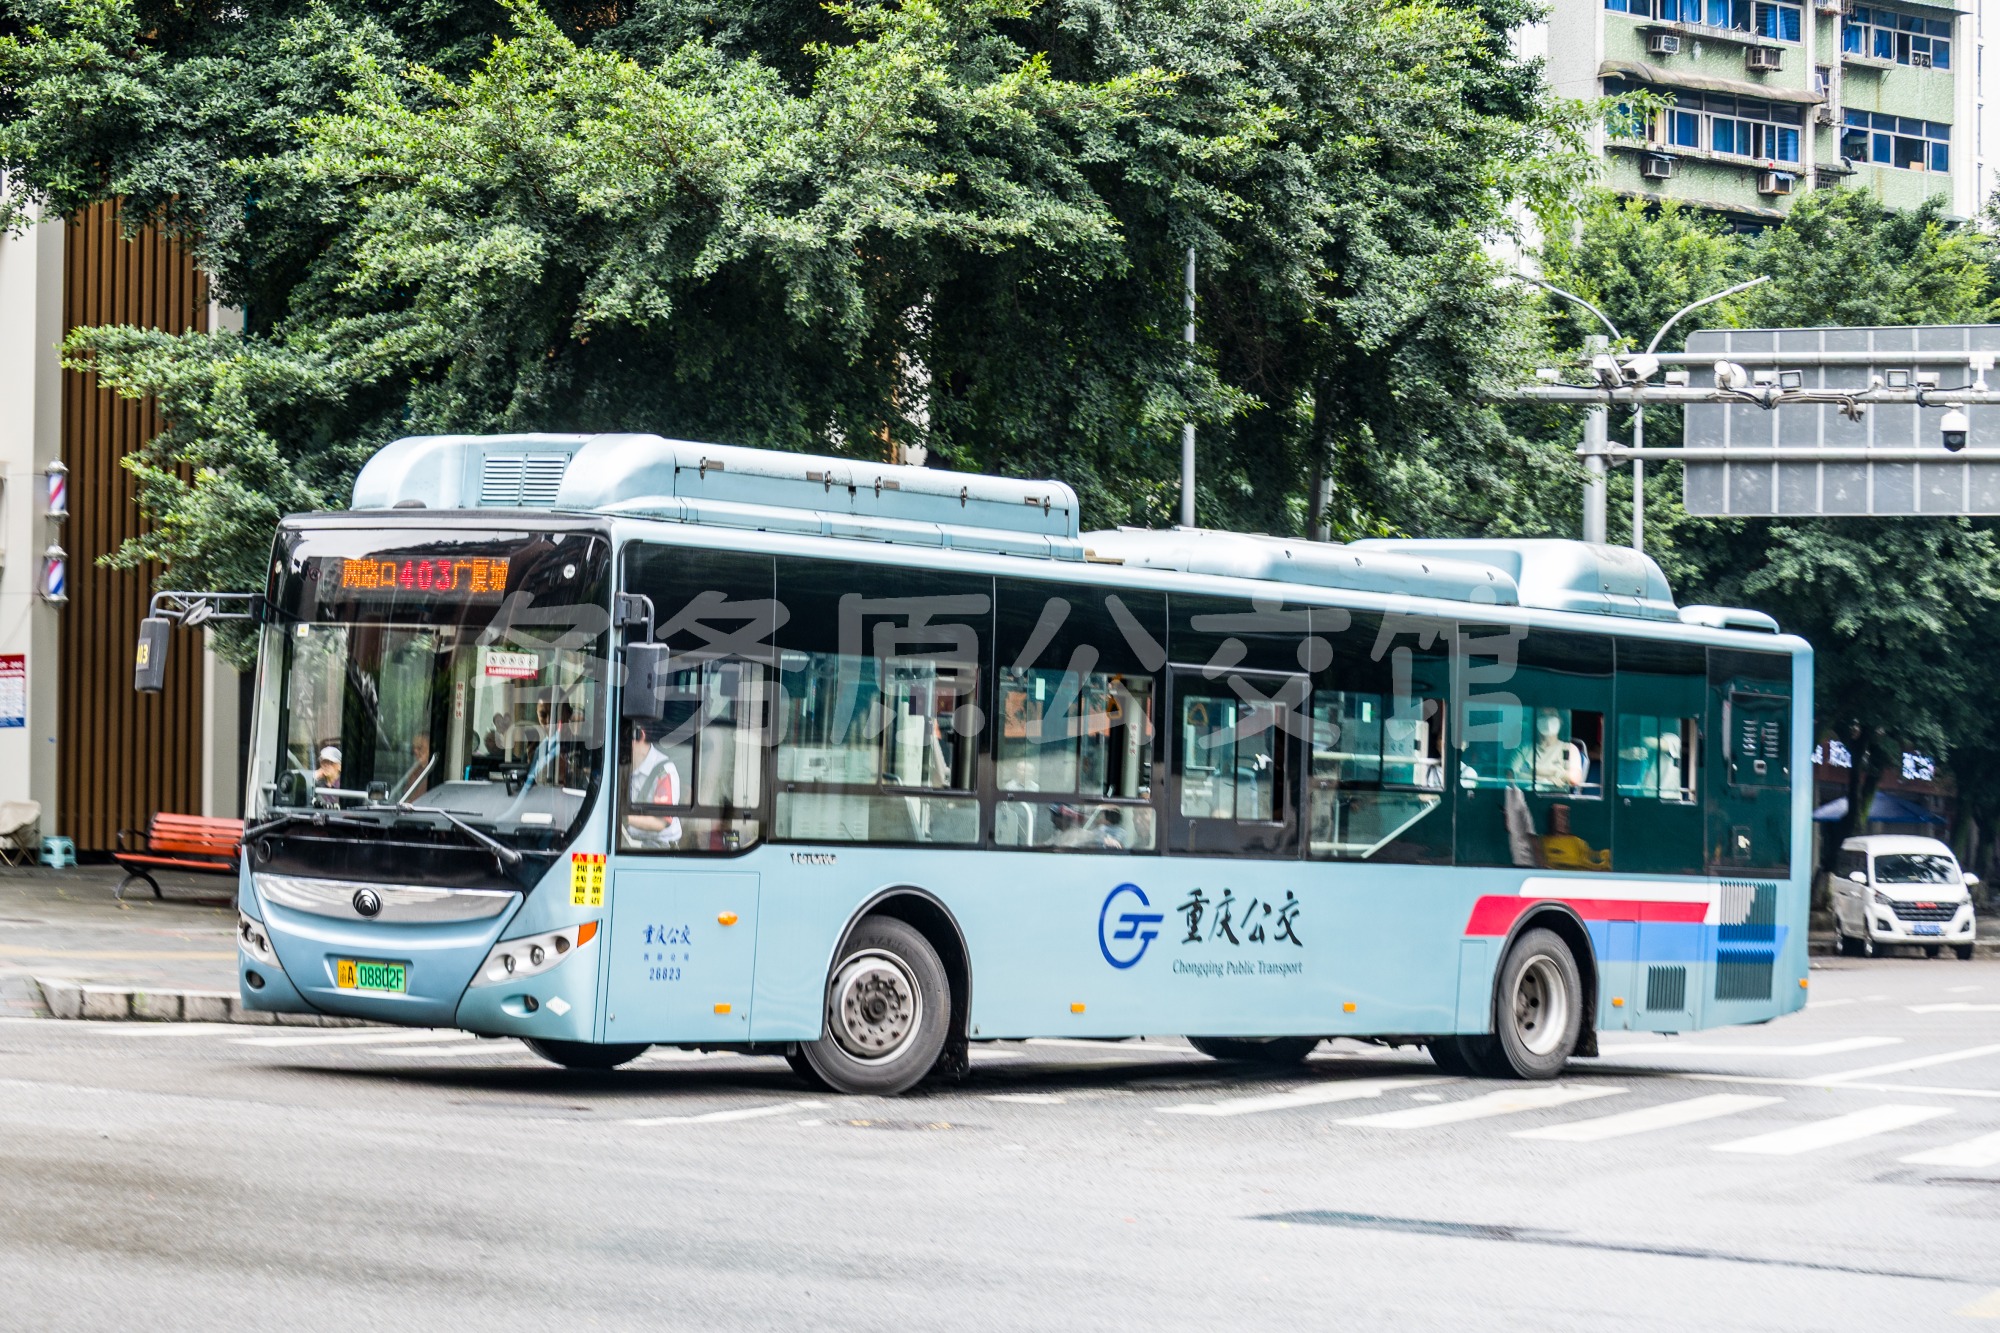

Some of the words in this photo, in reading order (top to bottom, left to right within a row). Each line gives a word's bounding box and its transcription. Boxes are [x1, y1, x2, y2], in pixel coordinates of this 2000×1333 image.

[399, 560, 451, 590] 403
[1176, 887, 1304, 948] 重庆公交
[642, 924, 692, 946] 重庆公交
[649, 966, 681, 981] 26823
[1172, 959, 1224, 979] Chongqing
[1226, 959, 1255, 976] Public
[1257, 960, 1303, 978] Transport
